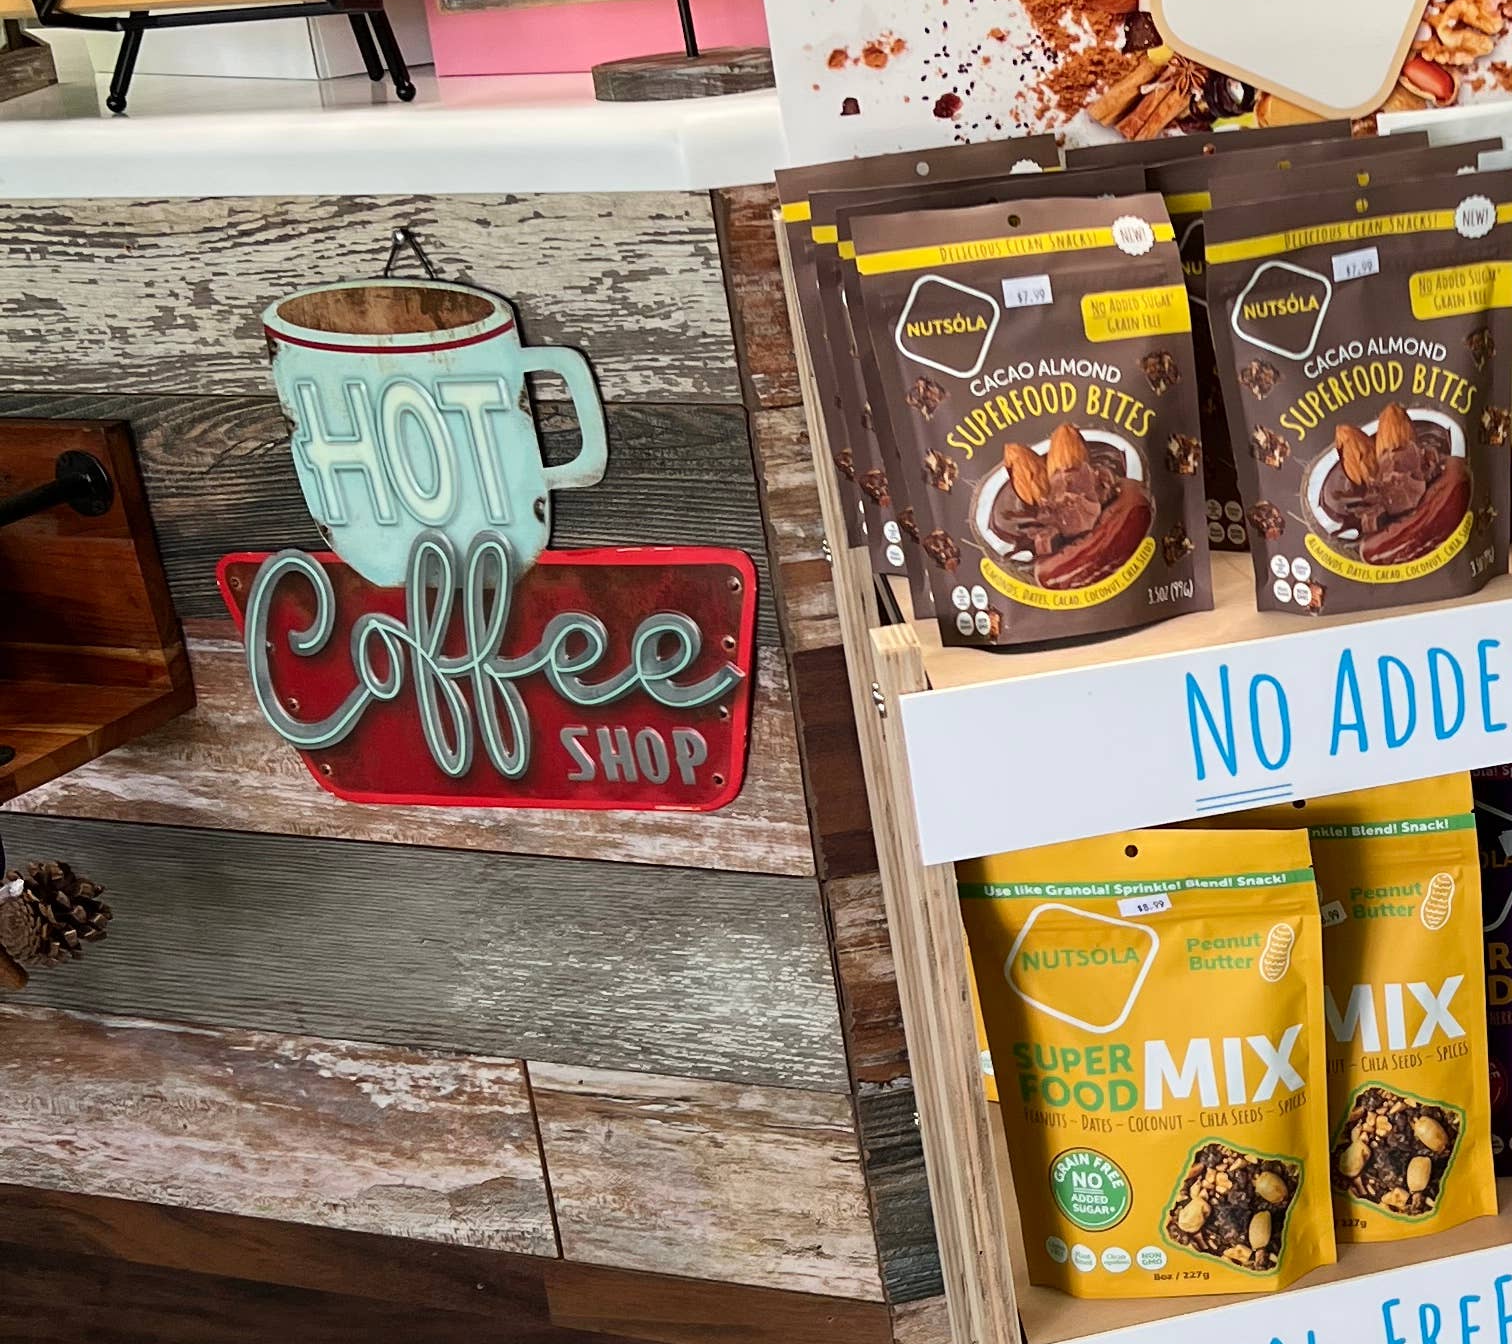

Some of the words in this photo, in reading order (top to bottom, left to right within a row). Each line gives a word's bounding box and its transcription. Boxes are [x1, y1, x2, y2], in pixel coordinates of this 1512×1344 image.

[1243, 292, 1319, 320] NUTSÓLA
[907, 313, 988, 338] NUTSÓLA
[1304, 341, 1364, 379] CACAO
[1367, 337, 1447, 362] ALMOND
[970, 362, 1035, 397] CACAO
[1038, 358, 1122, 384] ALMOND
[1279, 361, 1404, 441] SUPERFOOD
[1412, 363, 1477, 415] BITES
[946, 382, 1077, 460] SUPERFOOD
[1085, 384, 1156, 438] BITES
[296, 374, 511, 526] HOT
[245, 531, 745, 779] Coffee
[559, 726, 708, 785] SHOP
[1351, 824, 1398, 836] Blend!
[1401, 819, 1449, 833] Snack!
[984, 885, 1011, 897] Use
[1015, 884, 1042, 896] like
[1045, 884, 1110, 897] Granola!
[1114, 881, 1181, 897] Sprinkle!
[1236, 873, 1286, 887] Snack!
[1350, 882, 1422, 900] Peanut
[1353, 904, 1415, 919] Butter
[1186, 932, 1261, 952] Peanut
[1189, 955, 1253, 971] Butter
[1325, 975, 1466, 1052] MIX
[1013, 1043, 1133, 1075] SUPER
[1144, 1023, 1305, 1110] MIX
[1018, 1076, 1138, 1112] FOOD
[1128, 1114, 1182, 1131] COCONUT
[1200, 1111, 1229, 1128] CHIA
[1231, 1107, 1263, 1126] SEEDS
[1054, 1153, 1090, 1184] GRAIN
[1093, 1156, 1125, 1189] FREE
[1072, 1170, 1103, 1190] NO
[1071, 1193, 1108, 1205] ADDED
